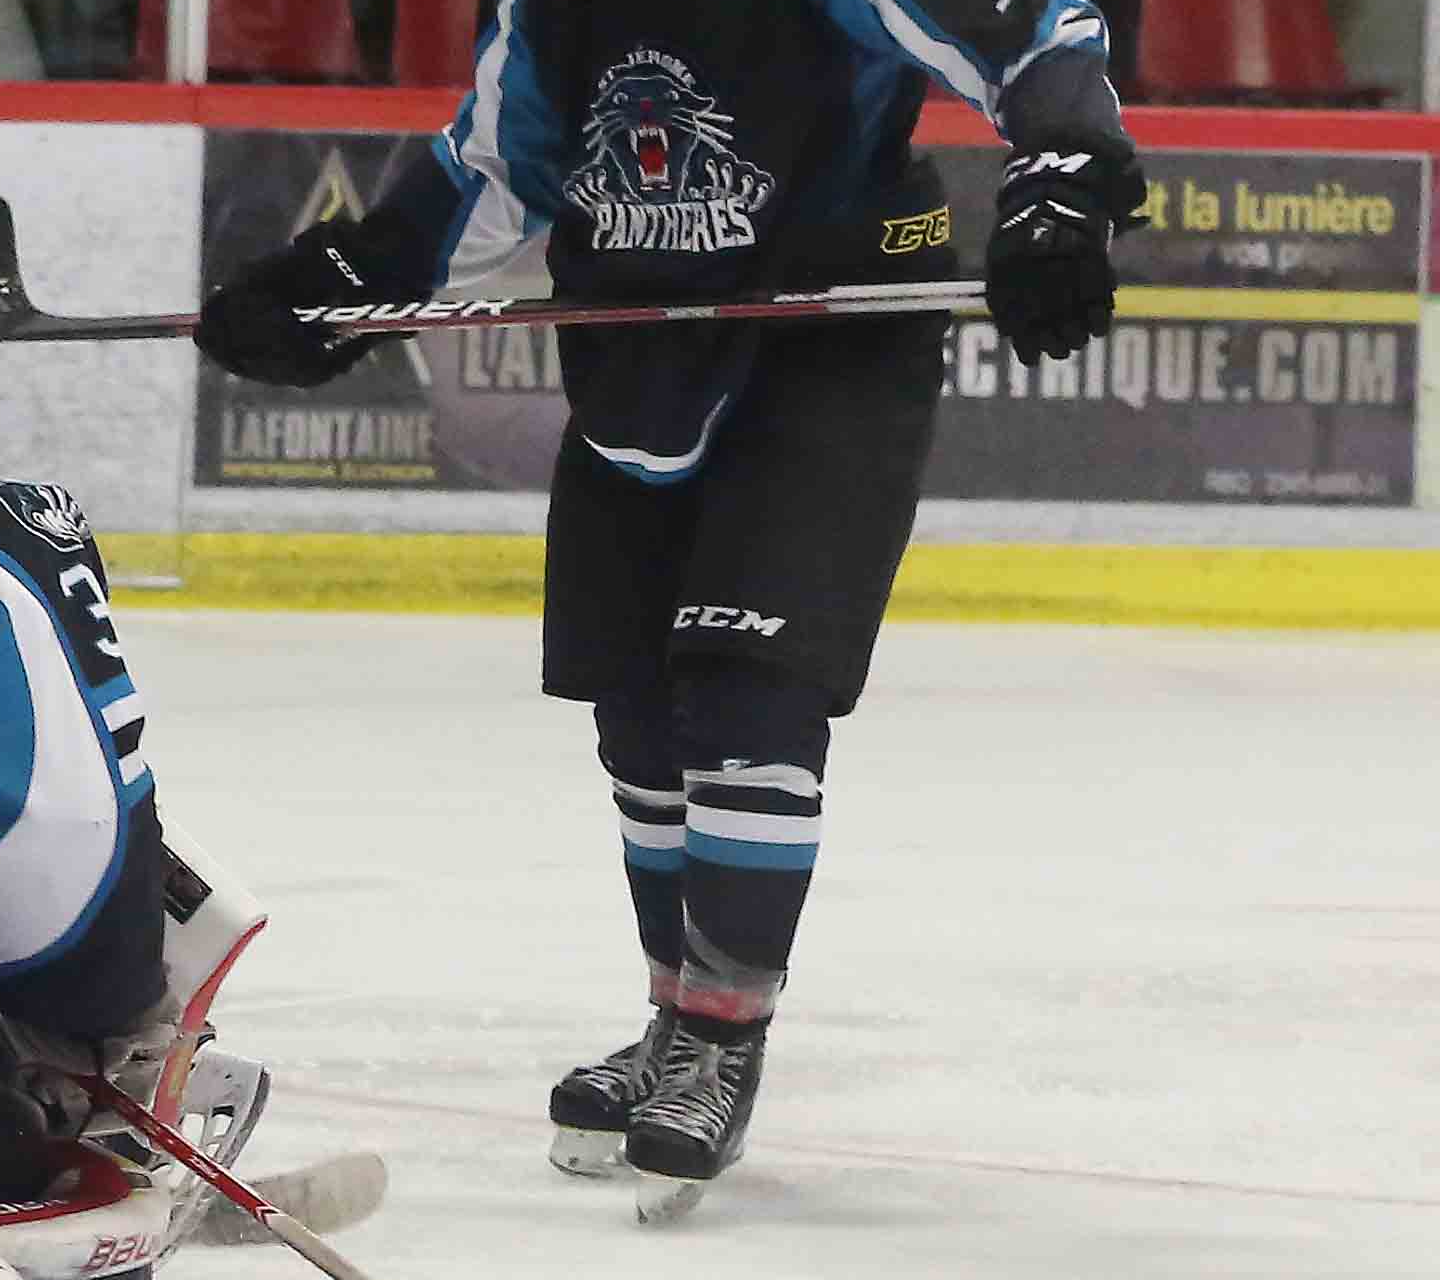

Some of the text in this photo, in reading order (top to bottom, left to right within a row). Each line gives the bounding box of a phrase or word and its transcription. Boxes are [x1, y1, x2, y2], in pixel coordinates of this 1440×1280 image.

[1183, 176, 1219, 231] la
[1235, 180, 1395, 235] lumière
[673, 605, 787, 638] CCM
